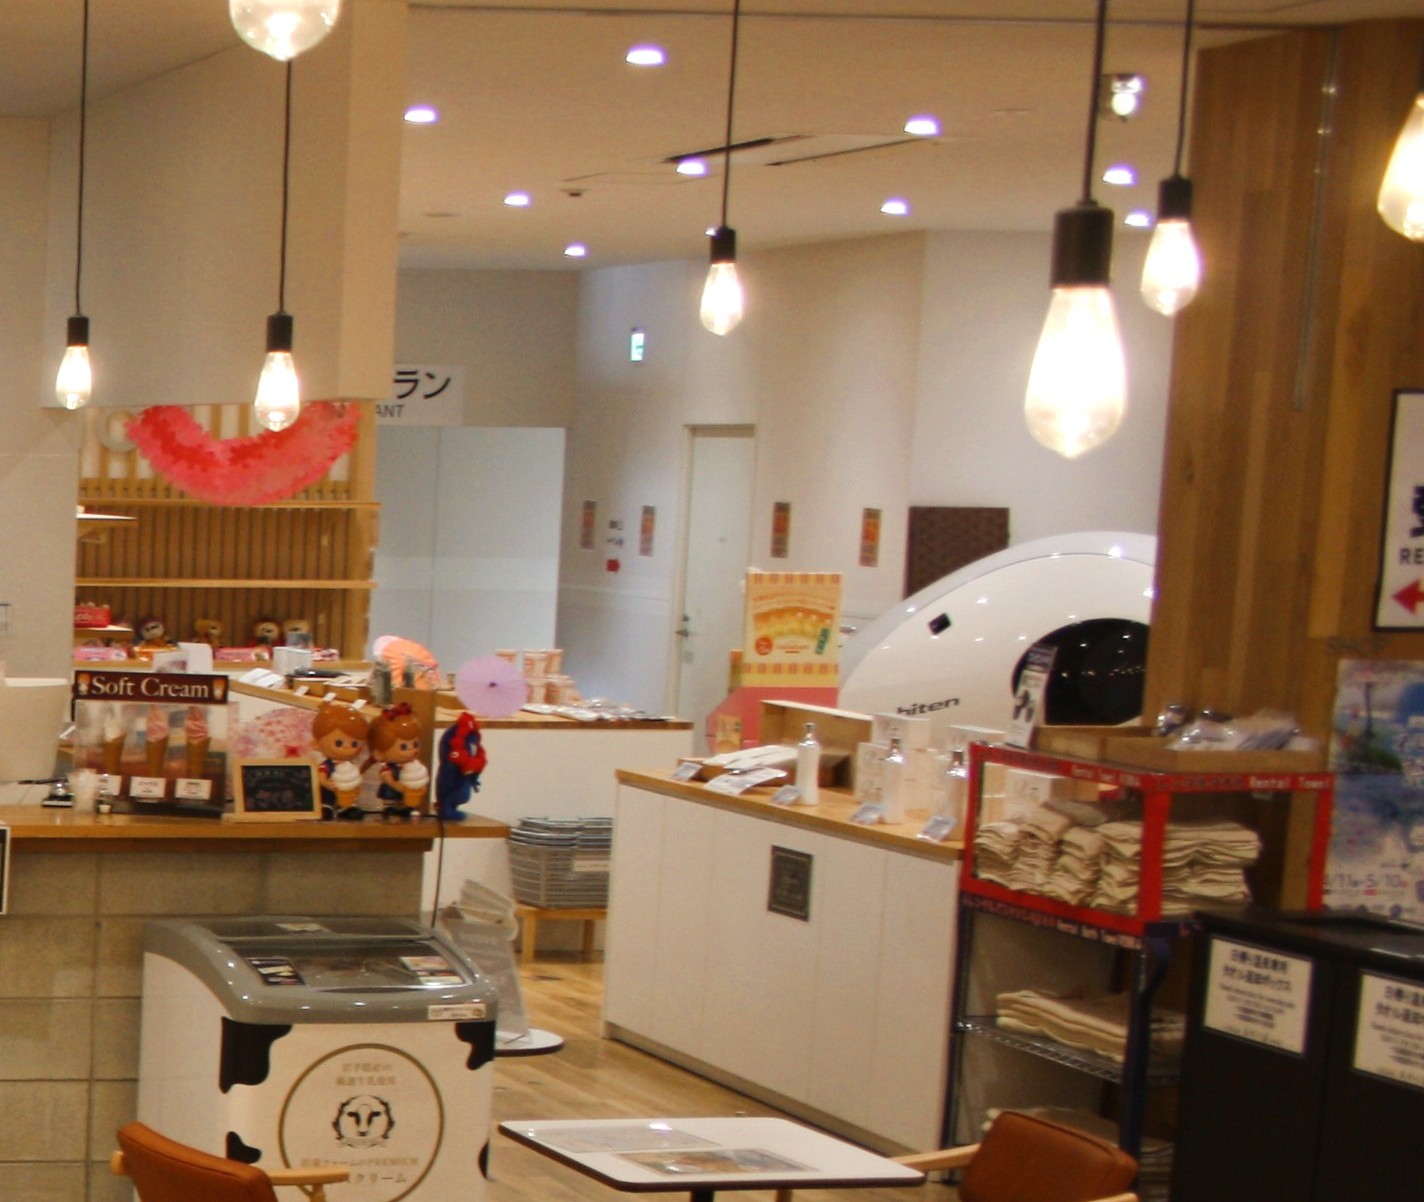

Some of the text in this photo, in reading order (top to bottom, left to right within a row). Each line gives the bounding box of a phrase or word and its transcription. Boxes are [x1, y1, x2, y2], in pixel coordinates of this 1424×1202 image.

[393, 370, 451, 399] ラン
[91, 676, 210, 699] Soft Cream
